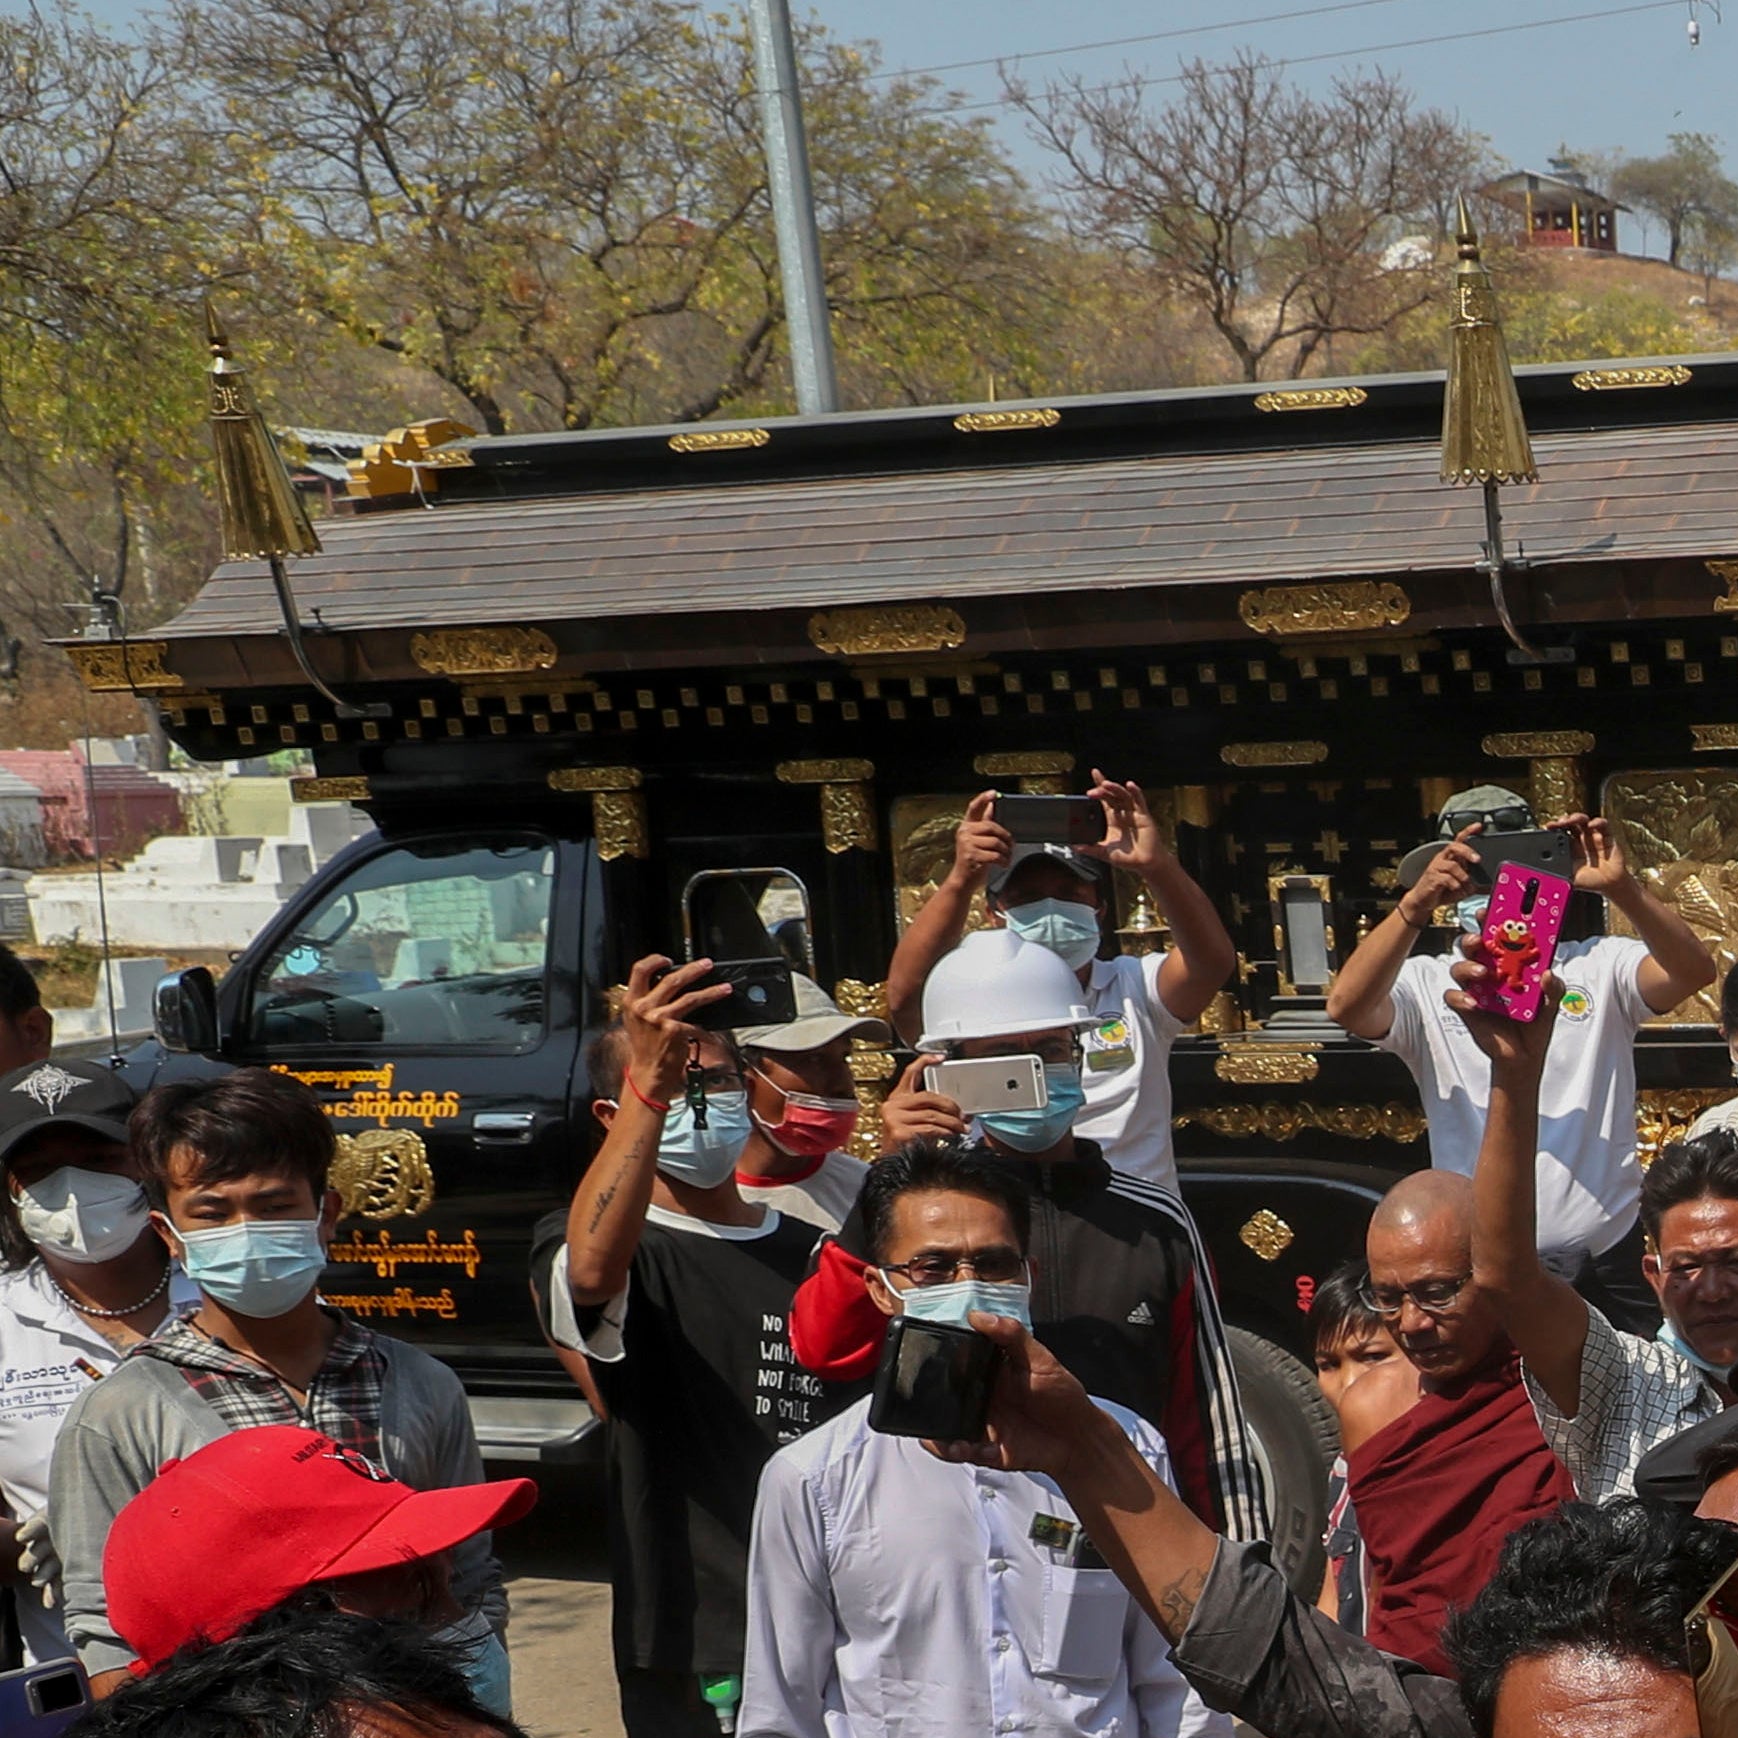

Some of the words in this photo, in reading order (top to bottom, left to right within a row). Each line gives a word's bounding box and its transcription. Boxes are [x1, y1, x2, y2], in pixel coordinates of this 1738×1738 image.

[762, 1314, 783, 1332] NO
[757, 1369, 785, 1389] NOT
[755, 1395, 771, 1415] TO
